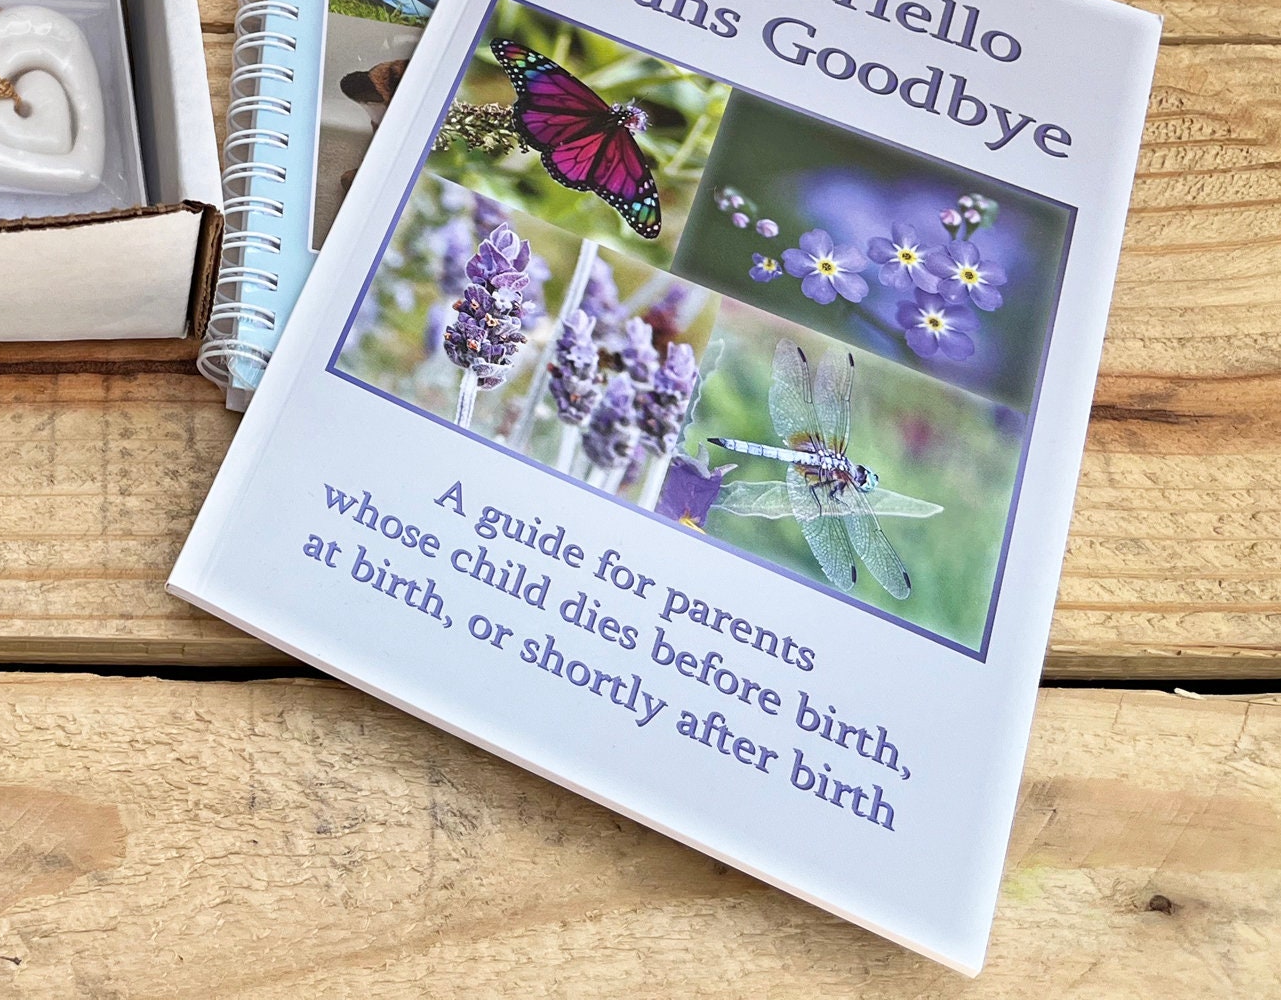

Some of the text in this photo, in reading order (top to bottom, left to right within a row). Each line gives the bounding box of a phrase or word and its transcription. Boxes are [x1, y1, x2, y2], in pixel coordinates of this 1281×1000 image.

[762, 17, 1072, 159] Goodbye
[303, 530, 897, 831] at birth, or shortly after birth
[323, 482, 912, 780] whose child dies before birth,
[434, 479, 817, 672] A guide for parents
